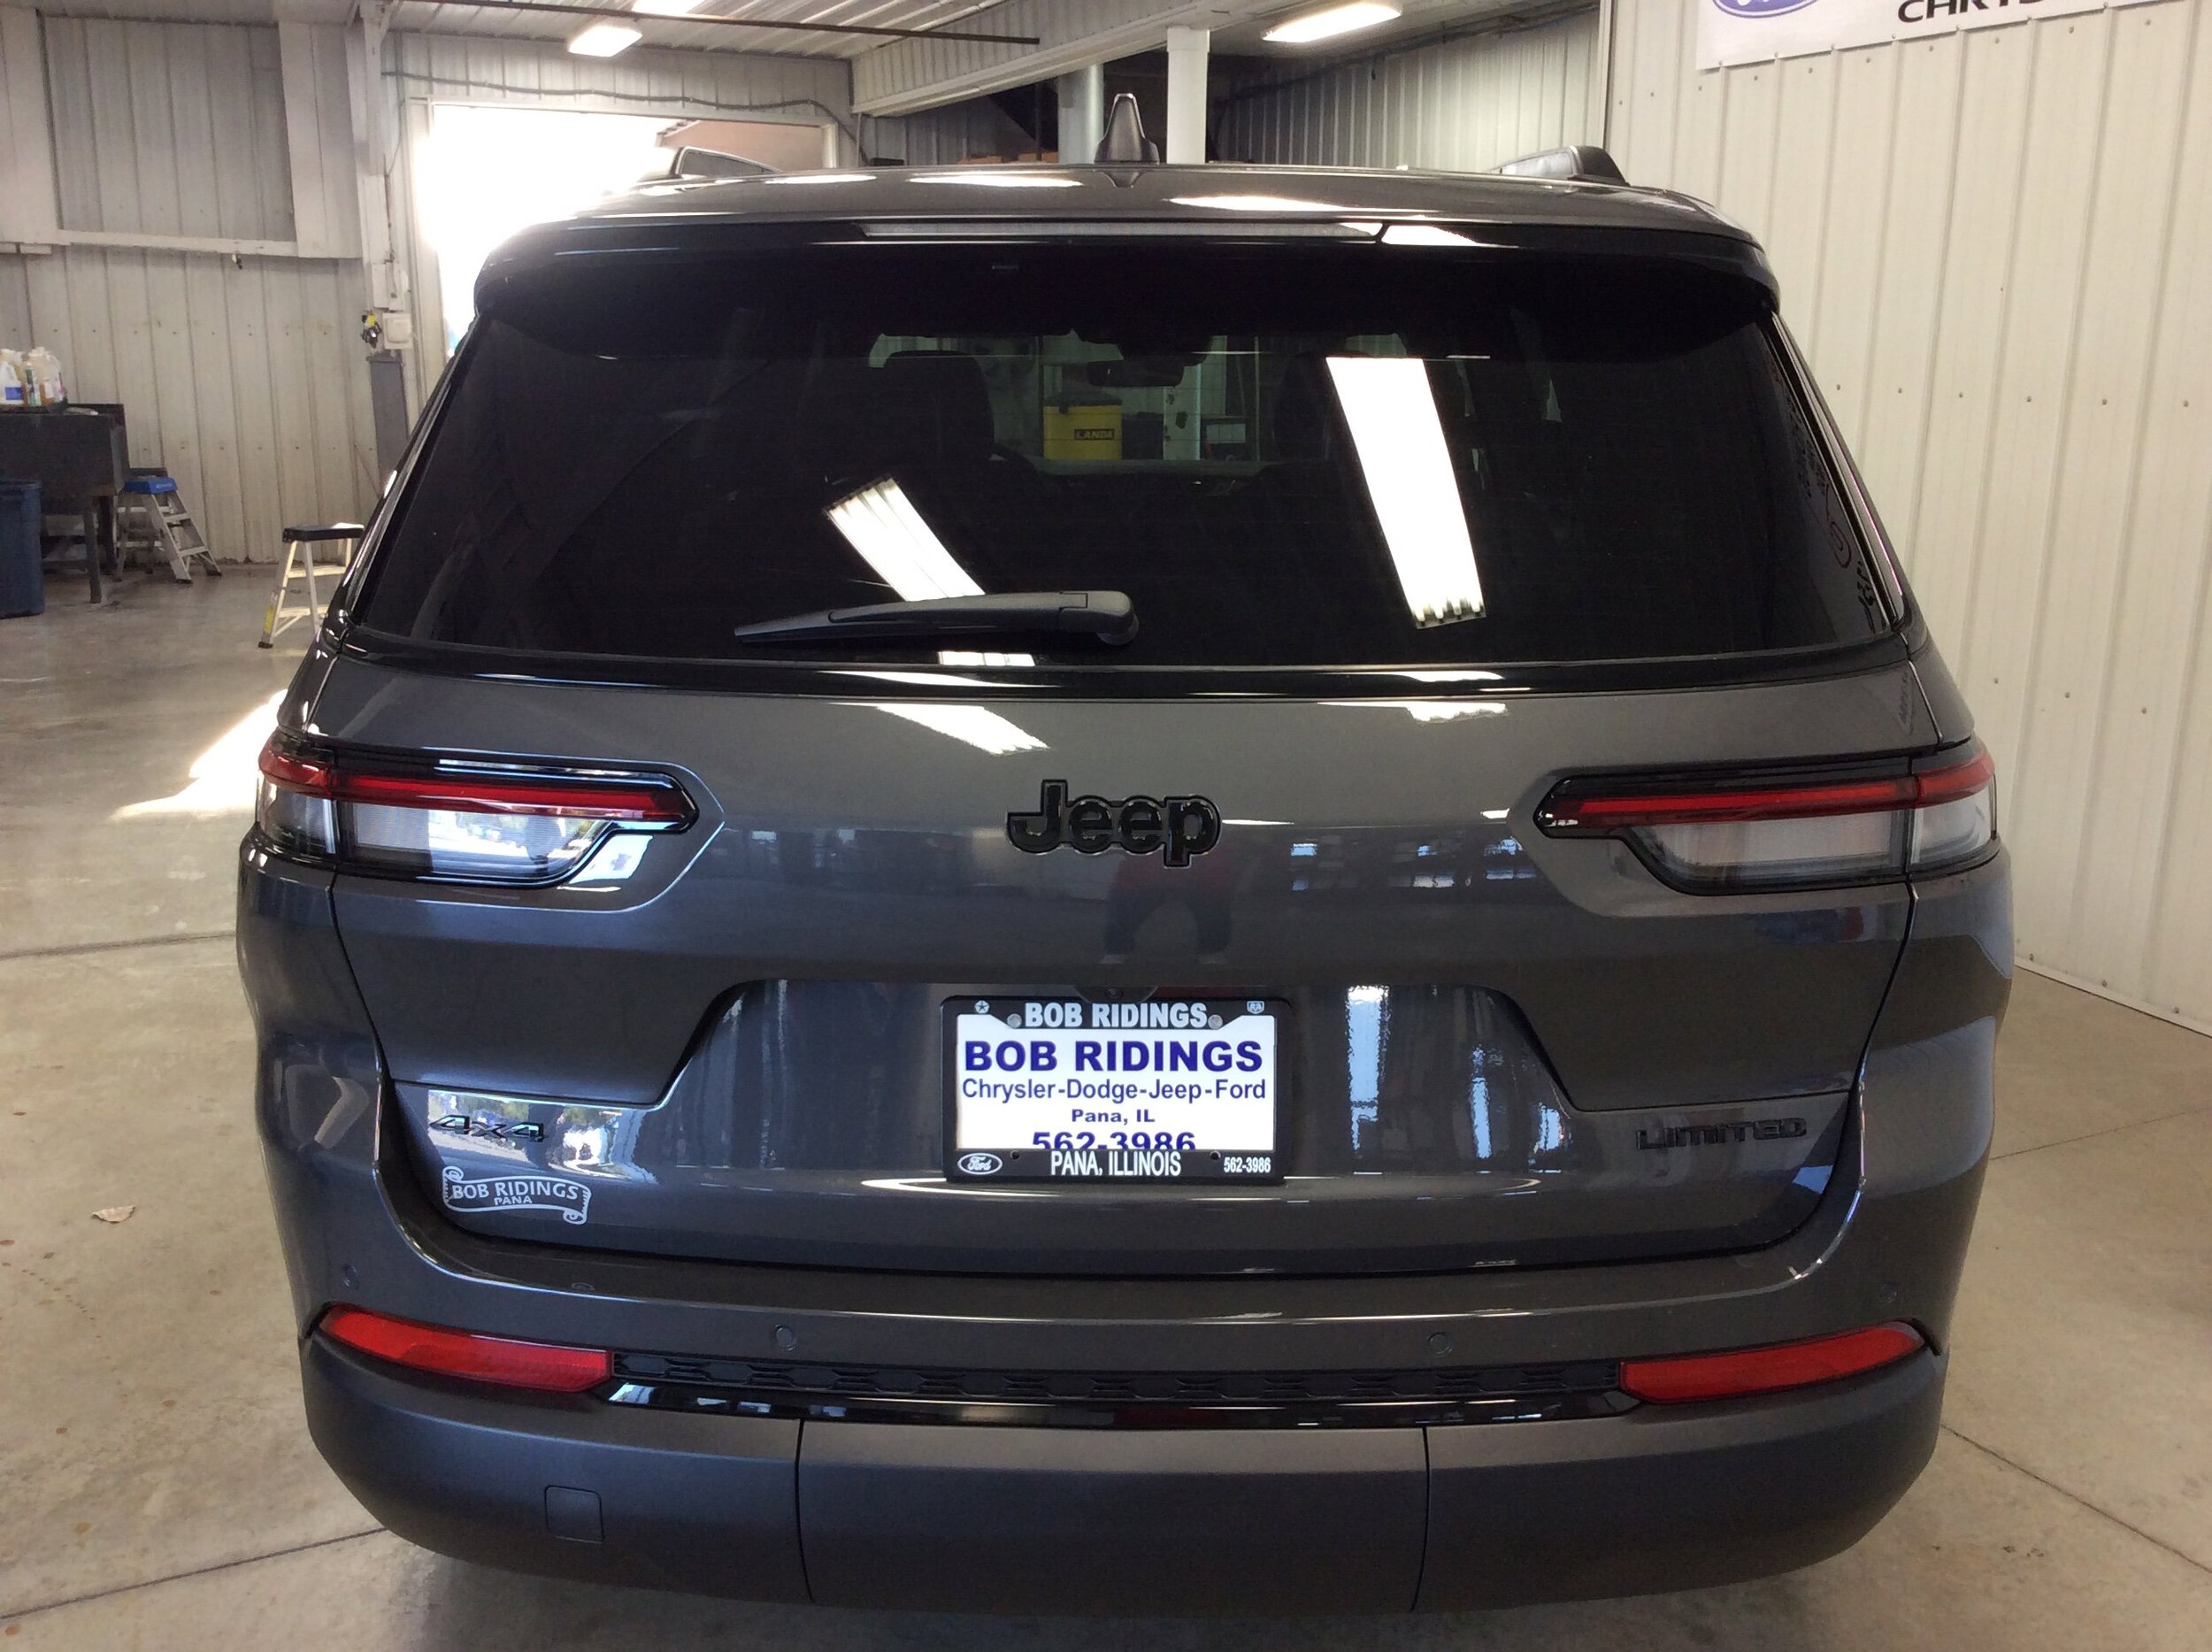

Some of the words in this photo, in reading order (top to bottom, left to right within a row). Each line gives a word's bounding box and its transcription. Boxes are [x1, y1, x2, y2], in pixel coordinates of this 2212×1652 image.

[1007, 779, 1221, 867] Jeep
[1025, 1003, 1083, 1028] BOB
[1091, 1003, 1208, 1028] RIDINGS
[964, 1040, 1058, 1072] BOB
[1074, 1040, 1263, 1072] RIDINGS
[1071, 1109, 1128, 1126] Pana,
[1136, 1109, 1156, 1122] IL
[1032, 1131, 1196, 1150] 562-3986
[1636, 1117, 1807, 1150] LIMITED
[1050, 1150, 1103, 1177] PANA,
[1108, 1150, 1182, 1177] ILLINOIS
[1223, 1156, 1271, 1173] 562-3986
[451, 1184, 489, 1200] BOB
[495, 1181, 579, 1201] RIDINGS
[494, 1195, 533, 1206] PANA
